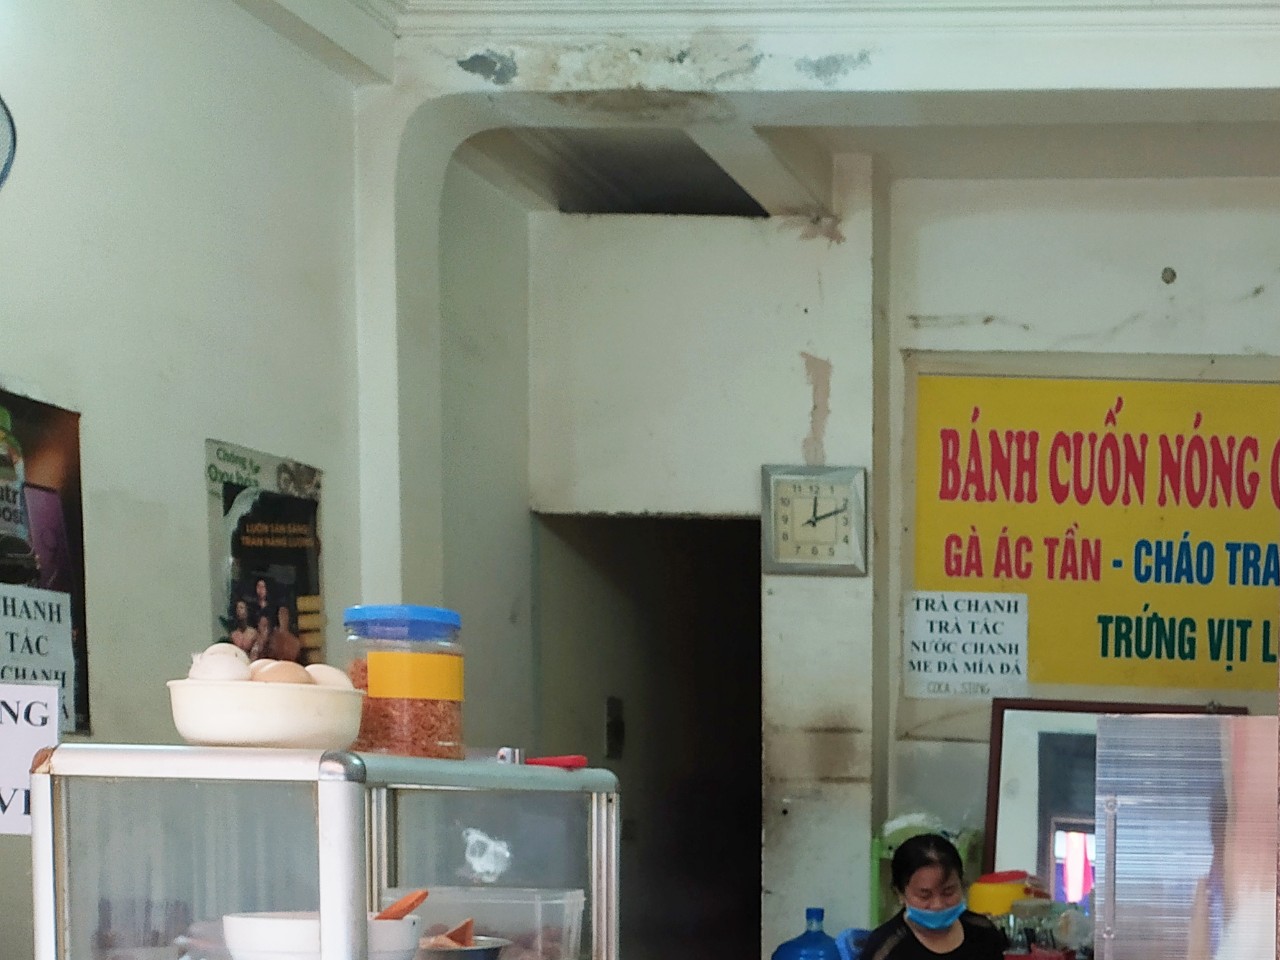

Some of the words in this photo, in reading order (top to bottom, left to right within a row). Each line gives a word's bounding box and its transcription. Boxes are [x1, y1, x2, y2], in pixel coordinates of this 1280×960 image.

[939, 406, 1039, 503] BÁNH
[1049, 396, 1148, 506] CUỐN
[1157, 411, 1260, 510] NÓNG
[944, 525, 983, 578] GÀ
[993, 526, 1034, 580] ÁC
[1043, 522, 1102, 581] TẦN
[1133, 531, 1215, 584] CHÁO
[912, 594, 948, 612] TRÀ
[953, 599, 1019, 613] CHANH
[927, 617, 962, 634] TRÀ
[1097, 603, 1197, 660] TRỨNG
[1207, 618, 1253, 672] VỊT
[961, 641, 1019, 656] CHANH
